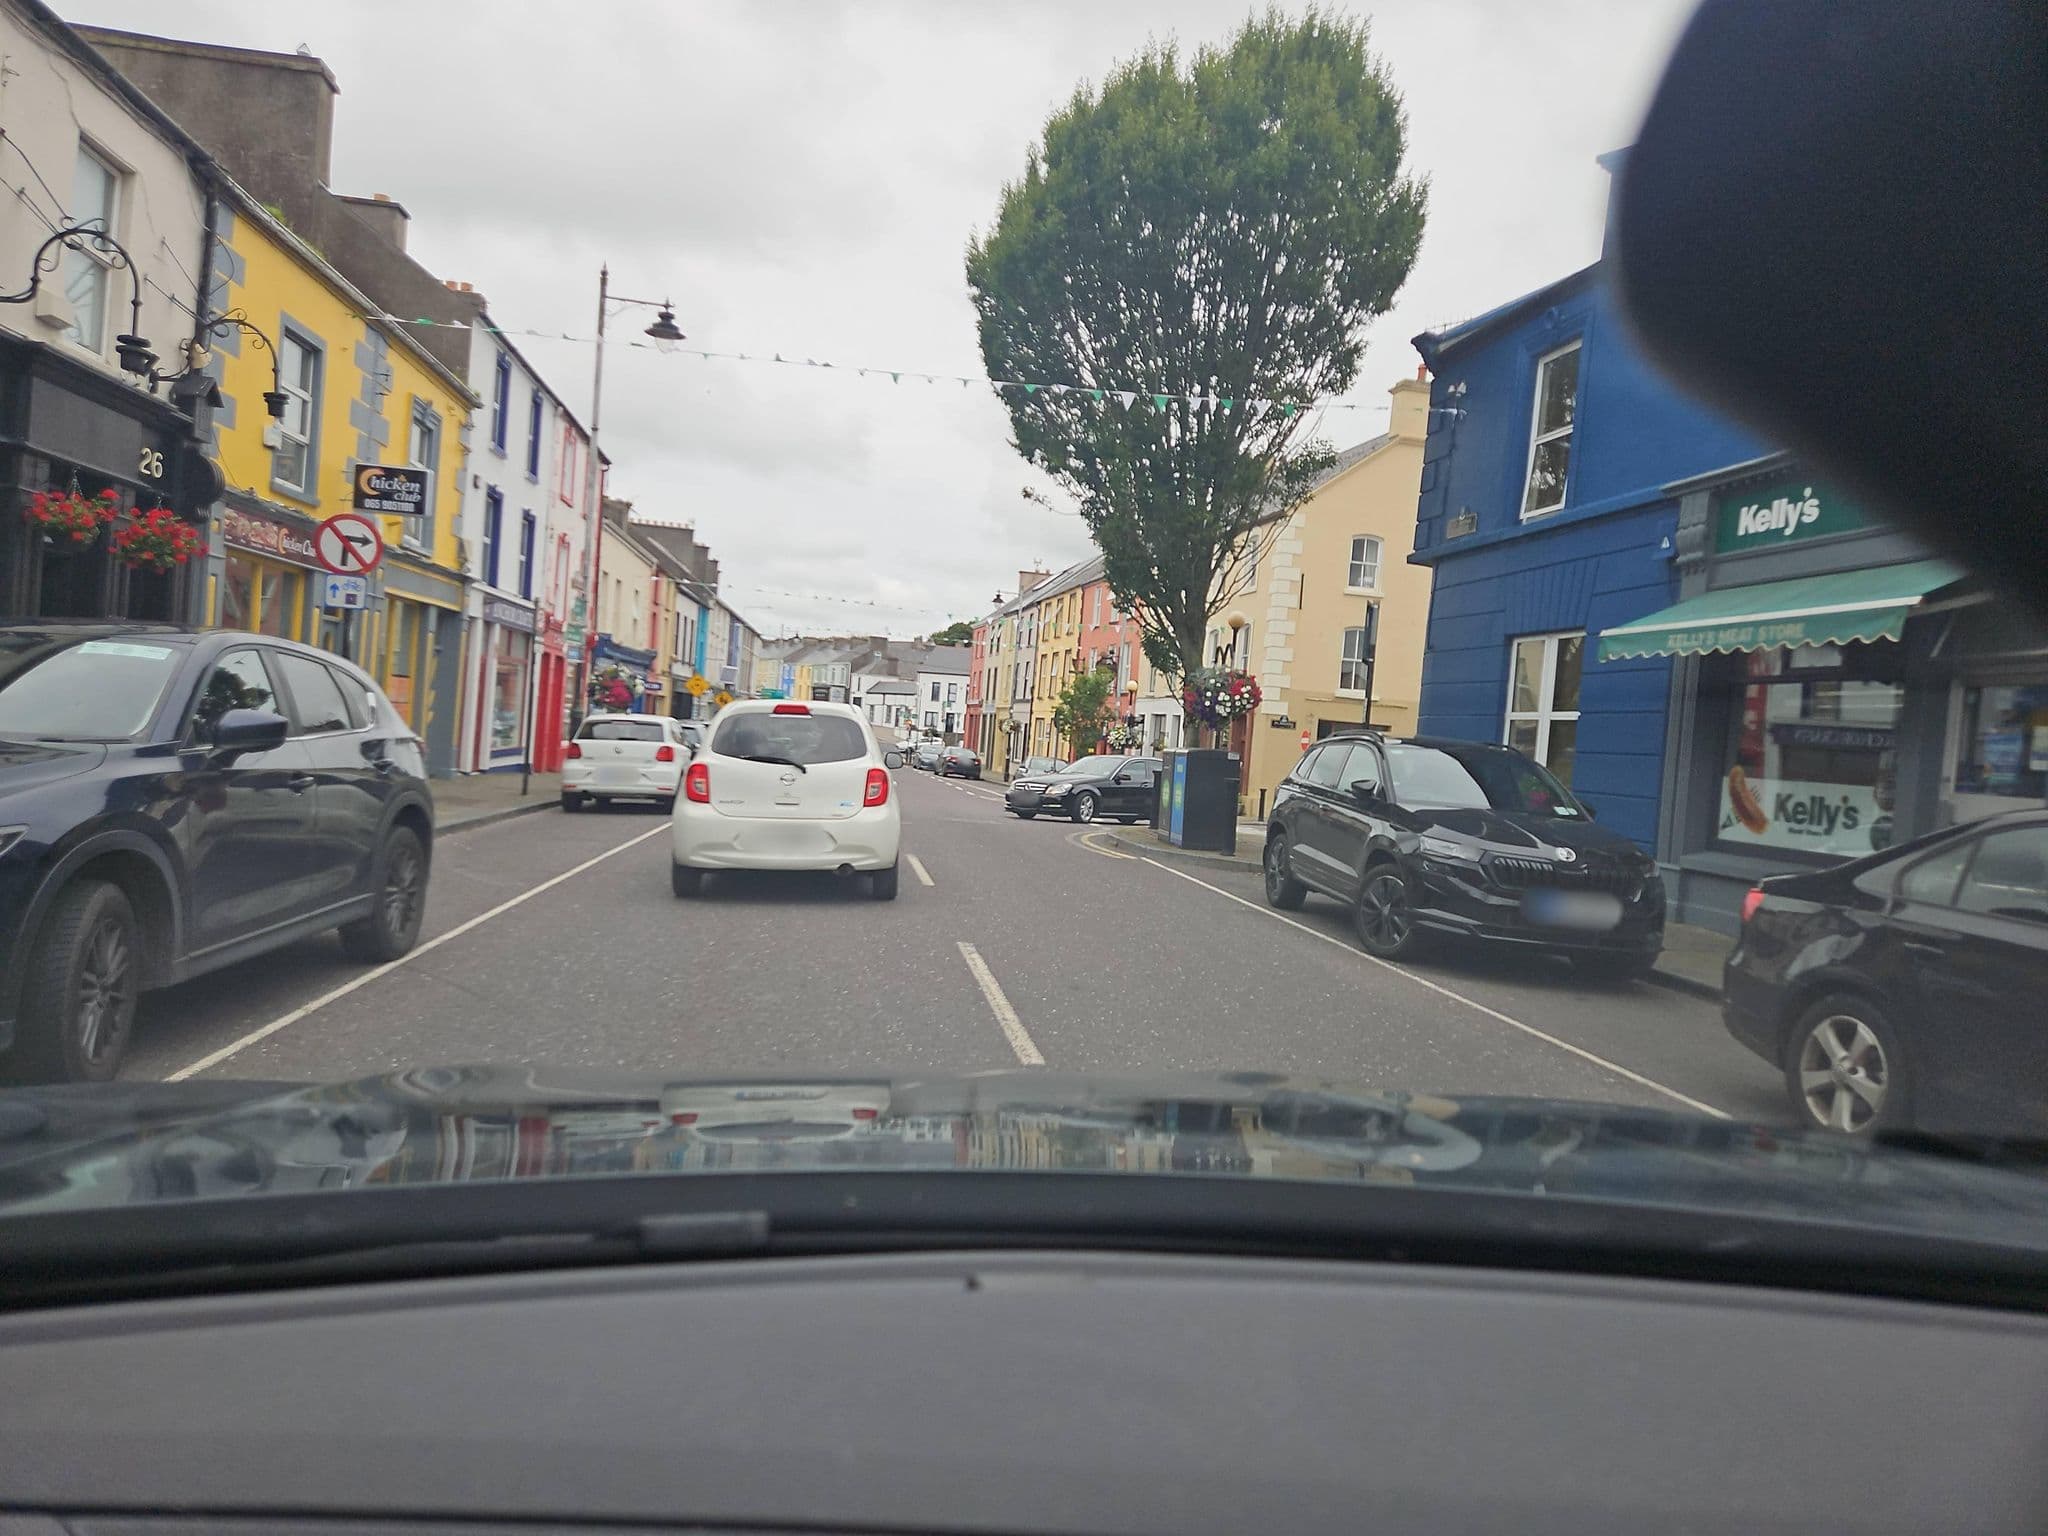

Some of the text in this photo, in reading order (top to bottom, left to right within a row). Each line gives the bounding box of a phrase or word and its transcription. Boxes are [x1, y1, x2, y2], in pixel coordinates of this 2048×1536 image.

[140, 447, 163, 478] 26
[360, 468, 421, 495] Chicken
[1737, 487, 1820, 536] Kelly's
[1667, 622, 1806, 648] KELLY'S MEAT STORE
[1774, 793, 1860, 836] Kelly's
